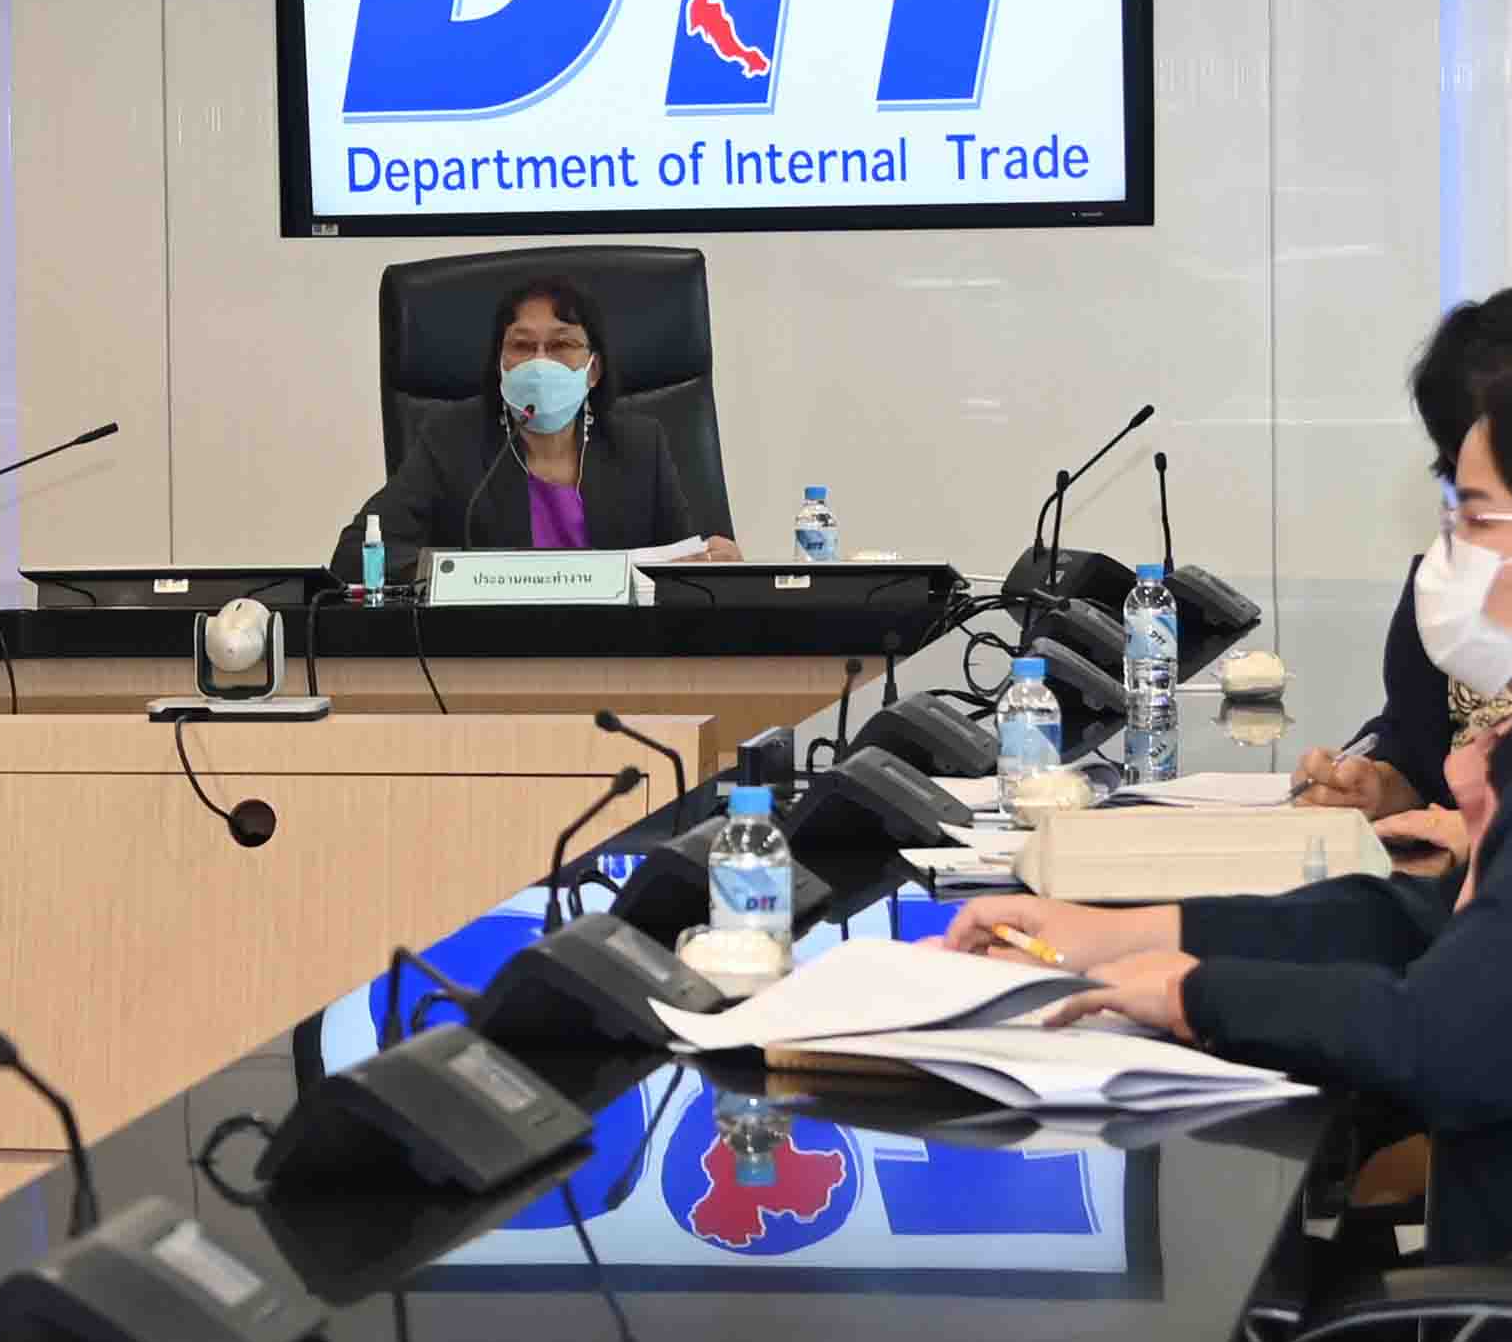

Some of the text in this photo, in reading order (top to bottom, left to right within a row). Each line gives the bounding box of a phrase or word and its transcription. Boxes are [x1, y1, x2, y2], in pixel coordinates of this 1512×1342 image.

[348, 133, 1090, 205] Department of Internal Trade
